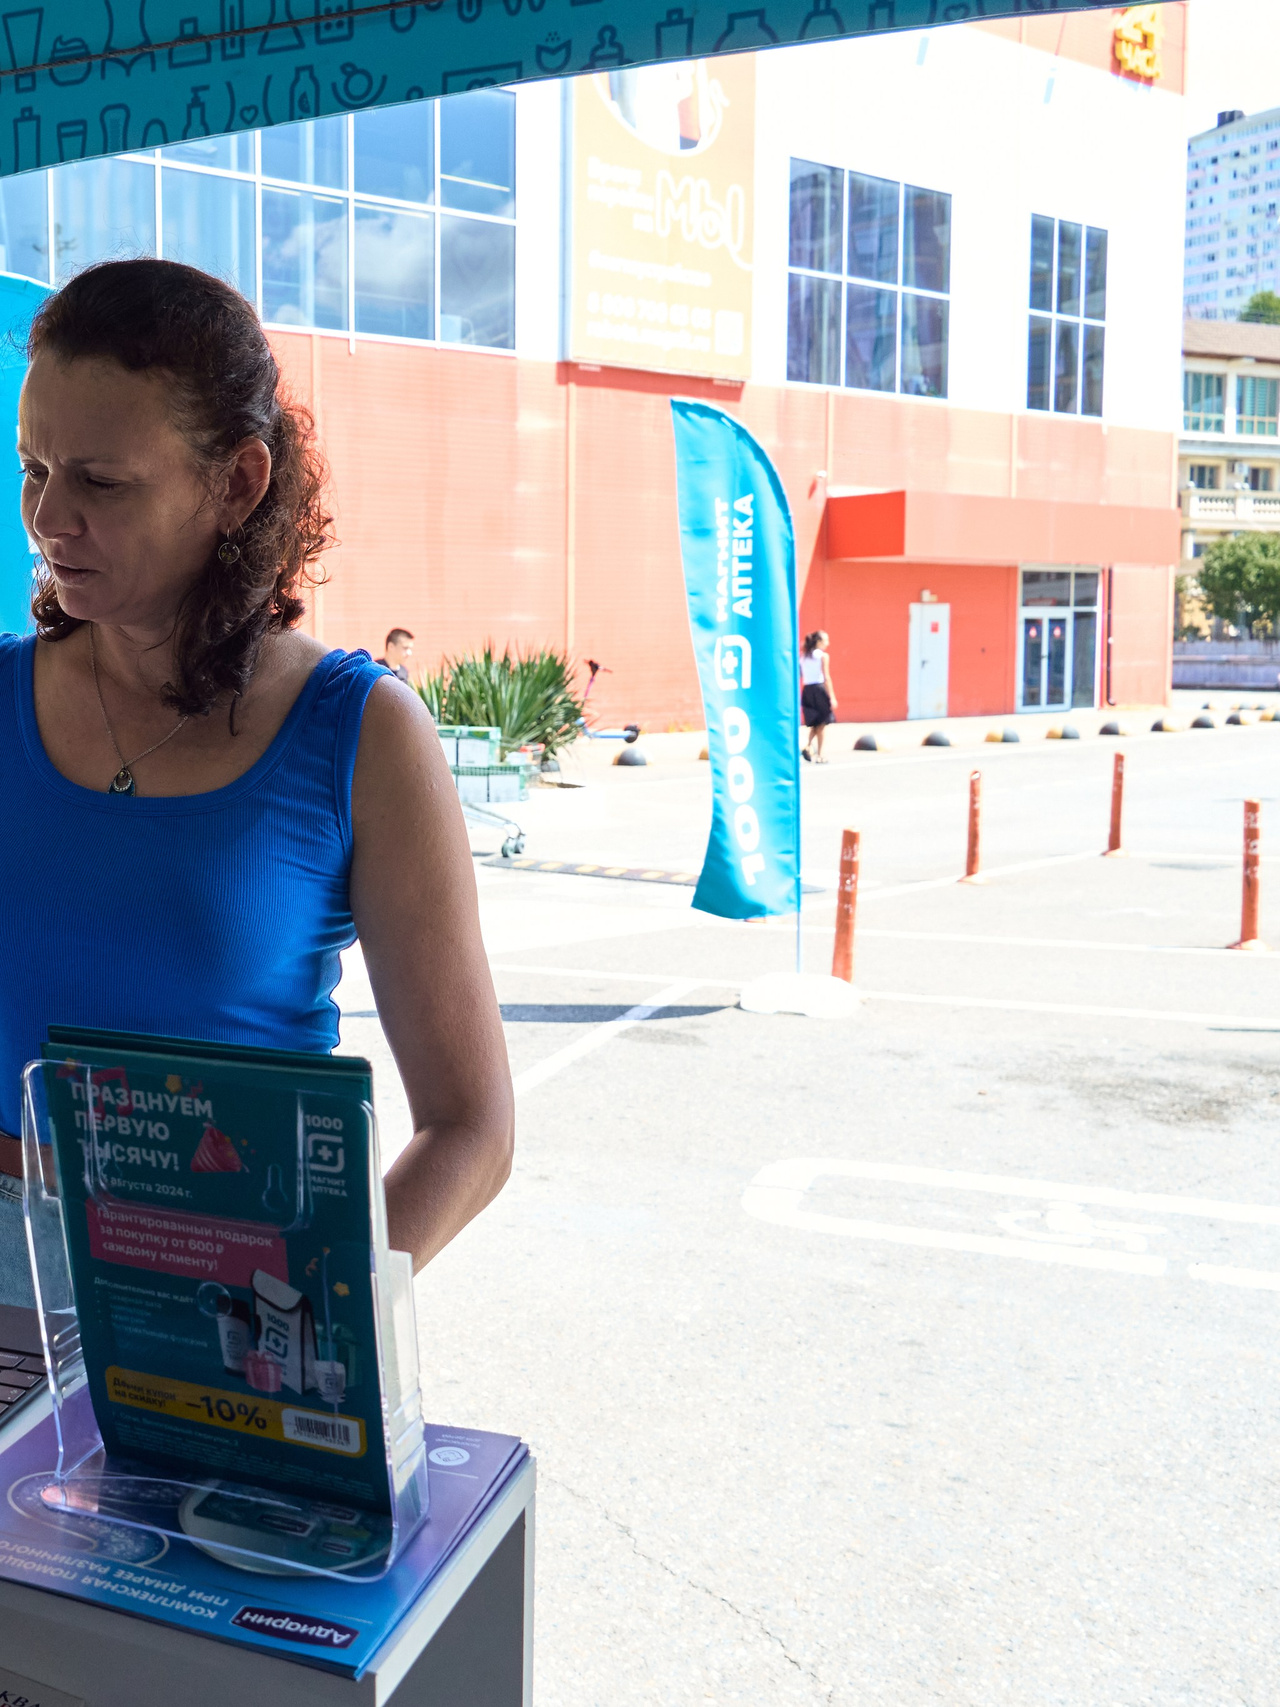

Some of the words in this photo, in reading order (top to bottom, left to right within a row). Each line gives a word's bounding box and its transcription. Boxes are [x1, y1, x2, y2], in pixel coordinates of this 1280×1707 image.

[732, 494, 753, 617] АПТЕКА
[723, 706, 767, 887] 1000
[71, 1082, 213, 1118] ПРАЗДНУЕМ
[74, 1110, 170, 1141] ПЕРВУЮ
[304, 1114, 343, 1131] 1000
[77, 1138, 180, 1171] ТЫСЯЧУ!
[111, 1177, 152, 1192] августа
[155, 1183, 184, 1196] 2024
[96, 1207, 213, 1238] Гарантированный
[215, 1229, 273, 1249] подарок
[116, 1226, 168, 1249] покупку
[171, 1238, 185, 1250] от
[160, 1250, 218, 1273] клиенту!
[115, 1389, 127, 1398] на
[81, 1575, 218, 1619] КОМПЛЕКСНАЯ
[111, 1567, 187, 1596] ДИАРЕЕ
[187, 1587, 230, 1608] ПРИ
[241, 1611, 351, 1645] Адиарин
